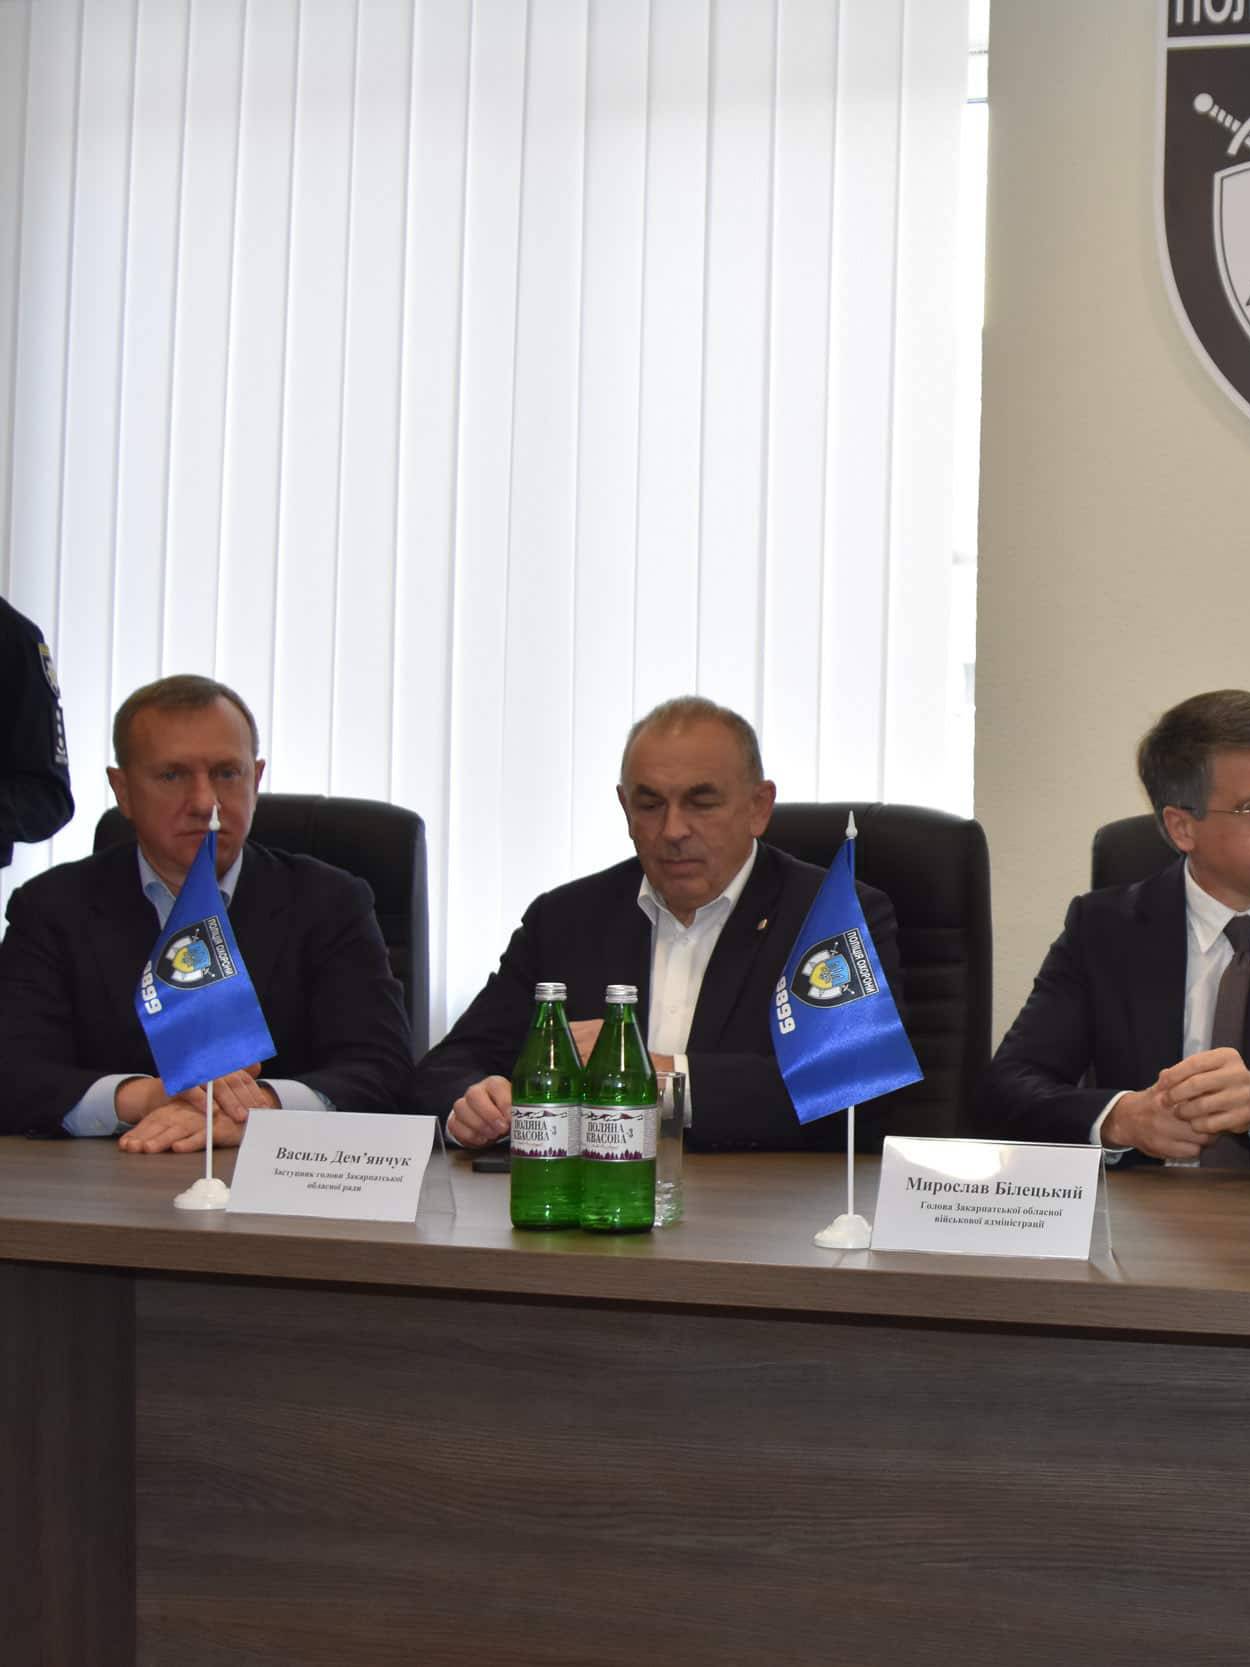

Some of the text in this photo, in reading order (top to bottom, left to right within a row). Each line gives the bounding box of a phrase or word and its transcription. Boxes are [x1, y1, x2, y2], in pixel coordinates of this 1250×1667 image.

[587, 1121, 624, 1133] ПОЛЯНА
[586, 1132, 627, 1144] КВАСОВА
[276, 1146, 328, 1162] Василь
[273, 1167, 403, 1183] Заступник голови Закарпатської
[307, 1181, 362, 1192] обласної ради
[906, 1177, 1083, 1200] Мирослав Білецький
[920, 1201, 1063, 1217] Голова Закарпатської обласної
[934, 1215, 1045, 1229] військової адміністрації
